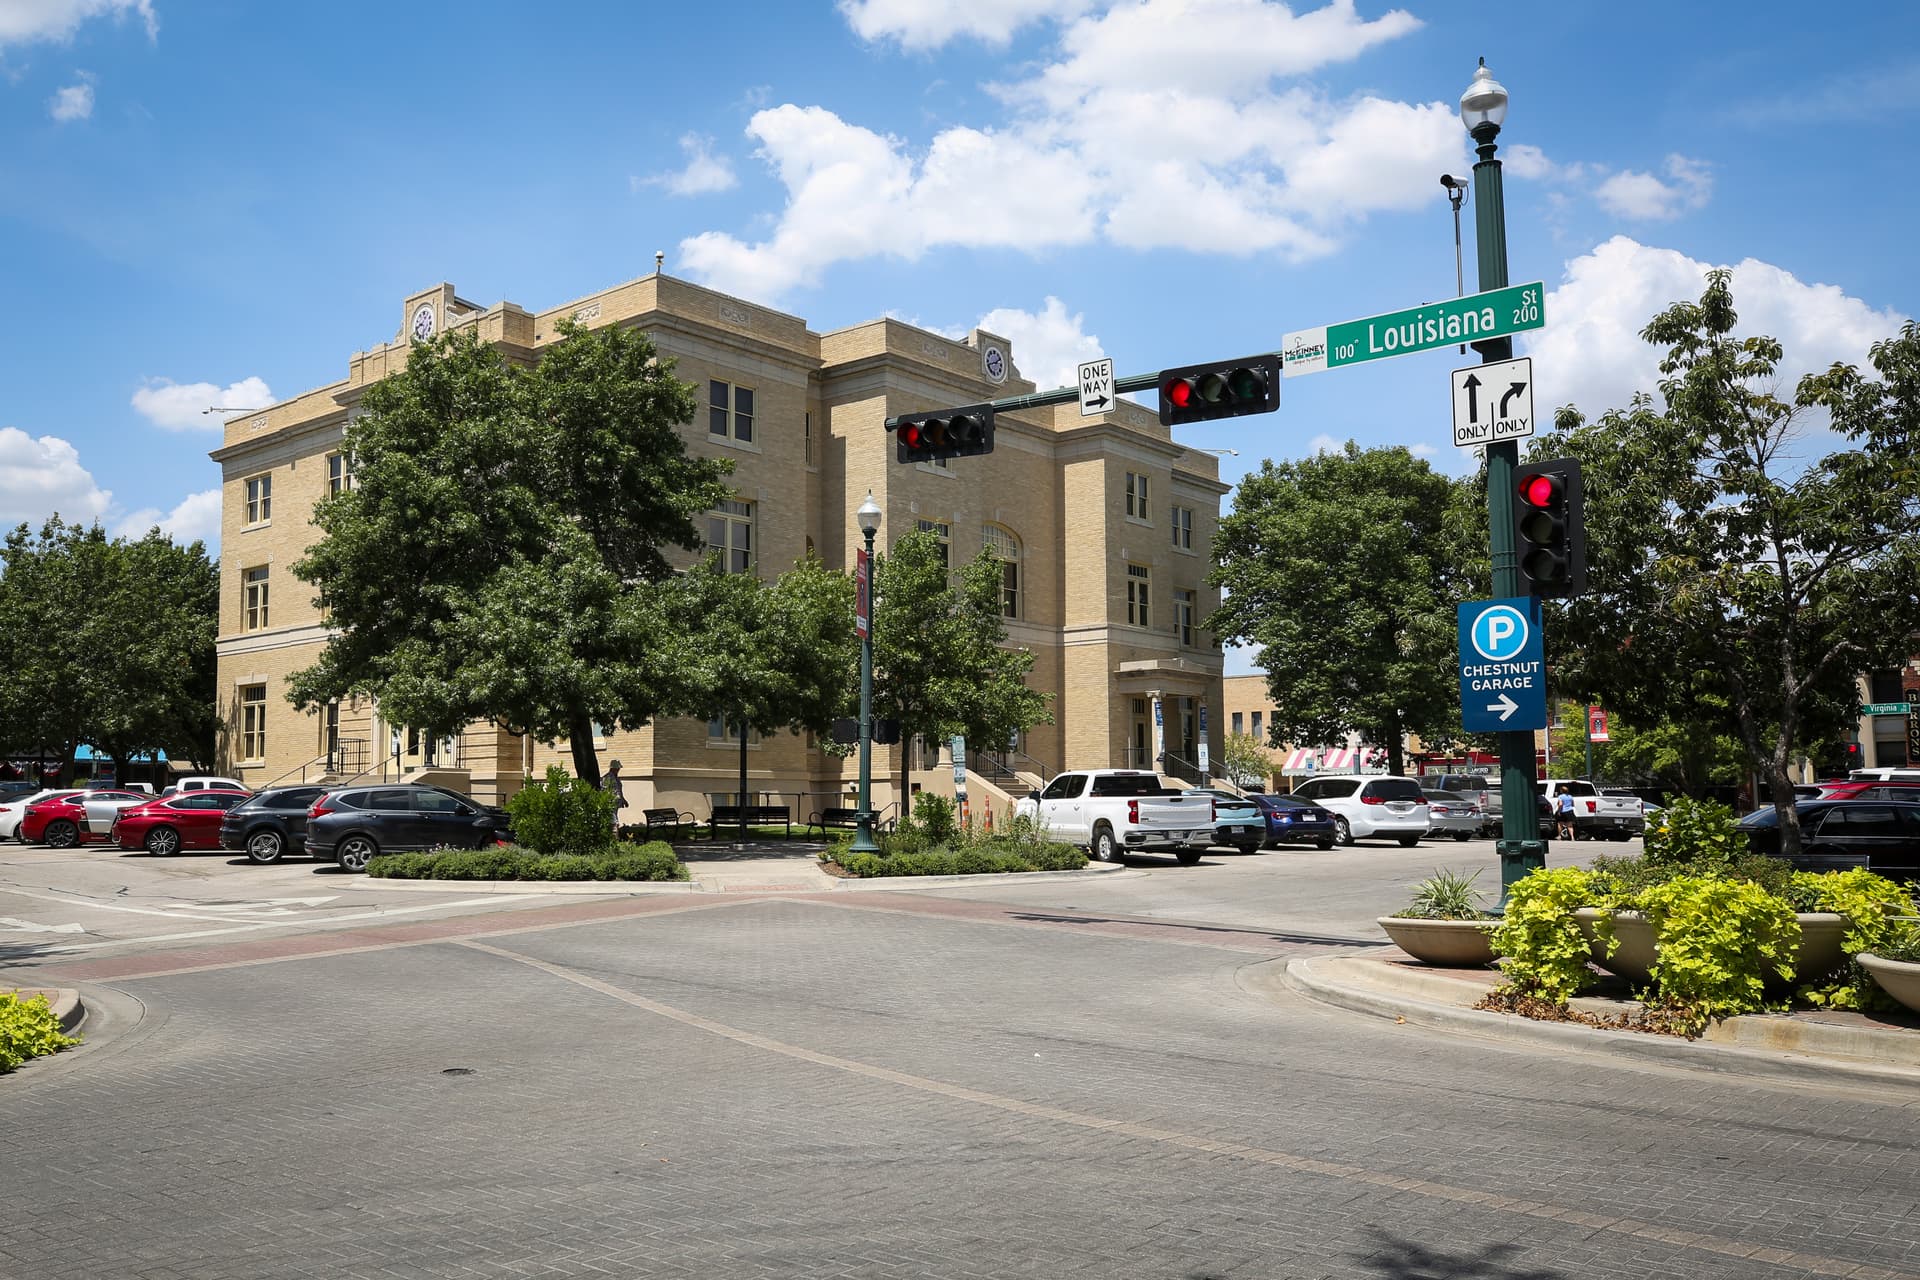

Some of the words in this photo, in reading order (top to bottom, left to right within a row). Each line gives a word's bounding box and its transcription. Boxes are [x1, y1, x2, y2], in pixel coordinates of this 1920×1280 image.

[1522, 289, 1537, 306] St
[1513, 306, 1538, 325] 200
[1335, 344, 1354, 360] 100
[1368, 307, 1495, 354] Louisiana
[1083, 363, 1109, 380] ONE
[1083, 378, 1109, 395] WAY
[1457, 423, 1489, 441] ONLY
[1495, 418, 1528, 434] ONLY
[1488, 616, 1515, 650] P
[1463, 661, 1540, 677] CHESTNUT
[1472, 677, 1533, 691] GARAGE
[1869, 703, 1897, 714] Virginia
[1909, 693, 1920, 756] BRRONS
